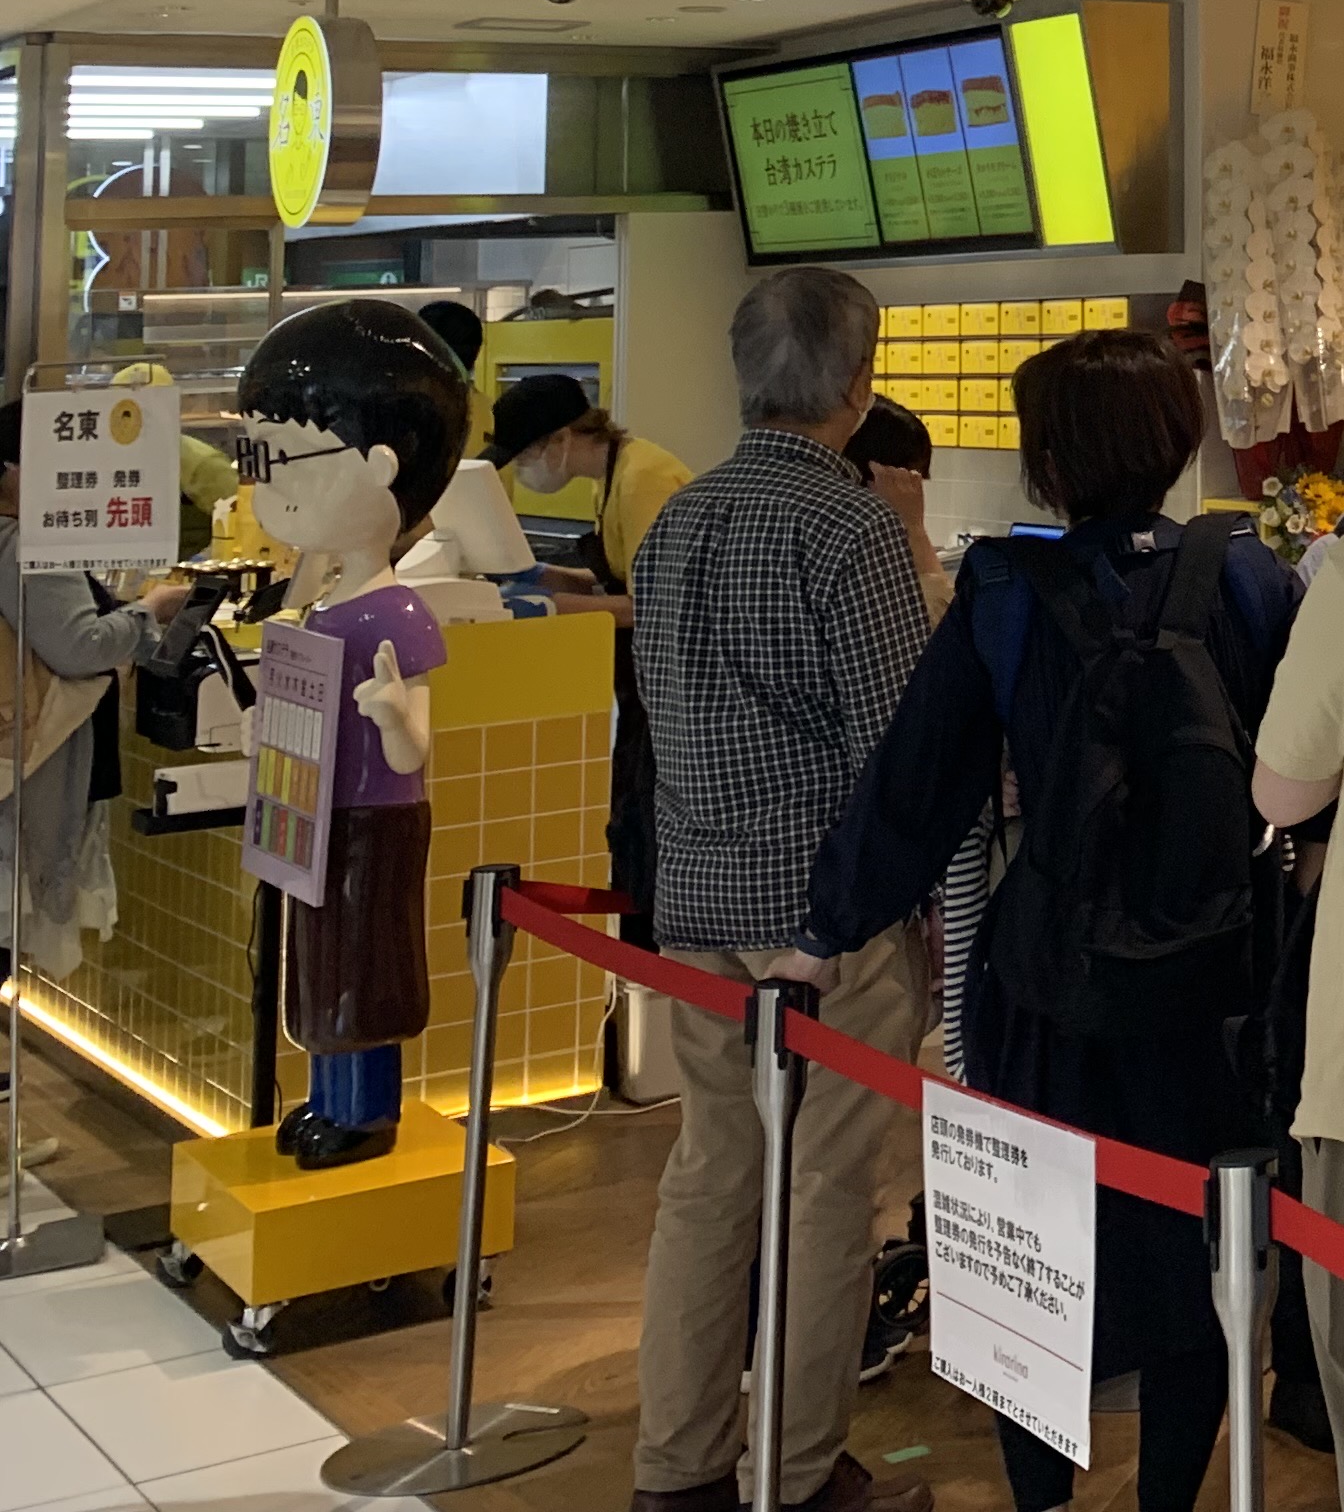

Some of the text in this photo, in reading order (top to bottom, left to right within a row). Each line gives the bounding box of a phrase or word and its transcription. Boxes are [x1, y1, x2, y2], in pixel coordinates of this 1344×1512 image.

[750, 108, 838, 147] 本日の焼き立て
[764, 153, 837, 186] 台湾カステラ
[53, 409, 100, 442] 名東
[55, 471, 98, 490] 整理券
[42, 496, 153, 528] お待ち列 先頭
